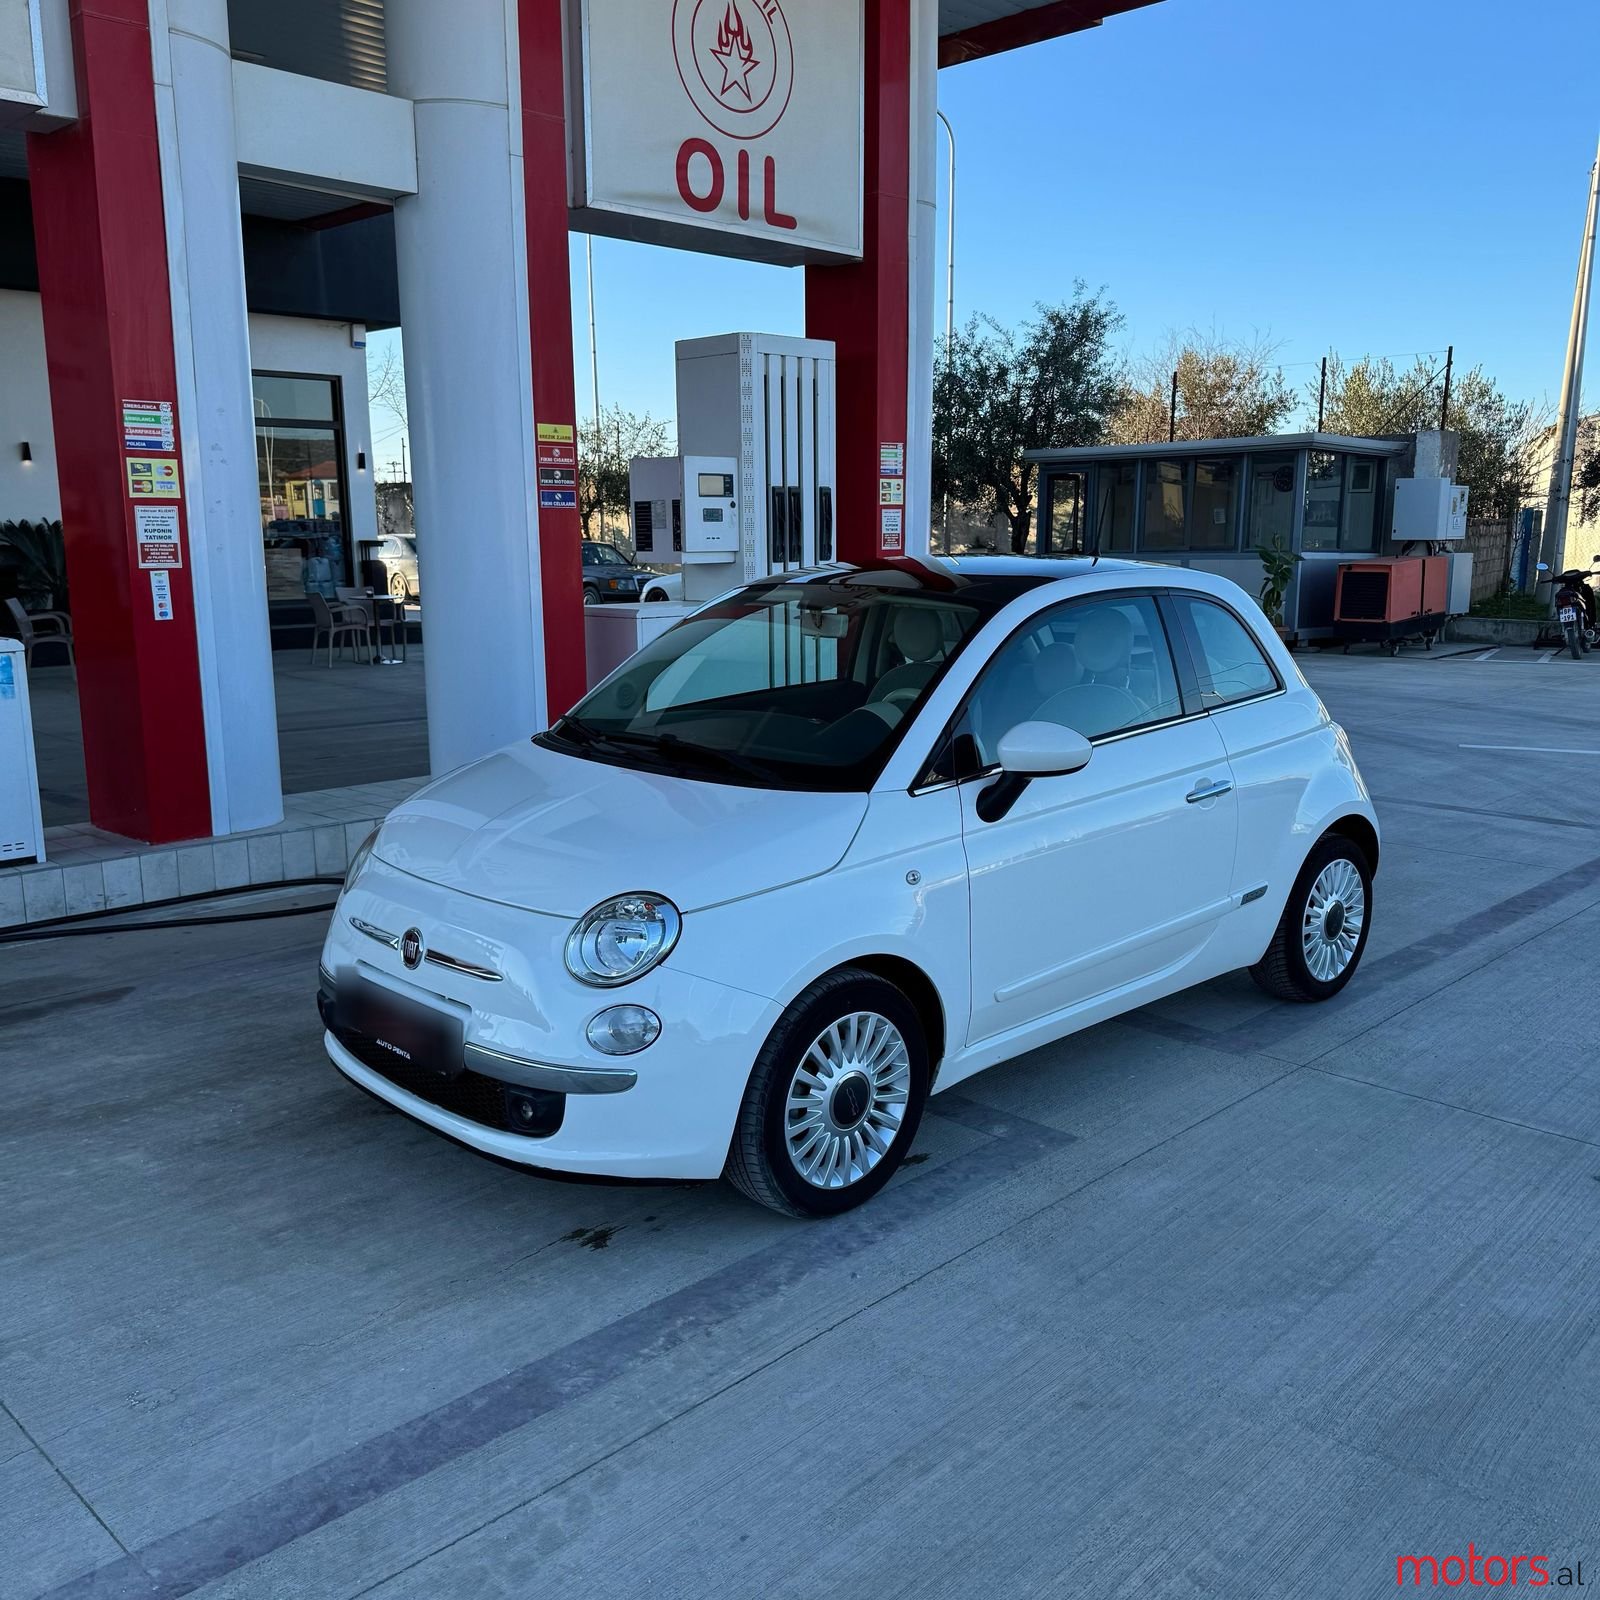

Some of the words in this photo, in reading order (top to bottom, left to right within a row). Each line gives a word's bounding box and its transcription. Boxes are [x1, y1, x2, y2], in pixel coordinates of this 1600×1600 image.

[676, 137, 797, 230] OIL
[405, 939, 418, 959] FIAT
[376, 1038, 392, 1050] AUTO
[392, 1046, 411, 1060] PENTA
